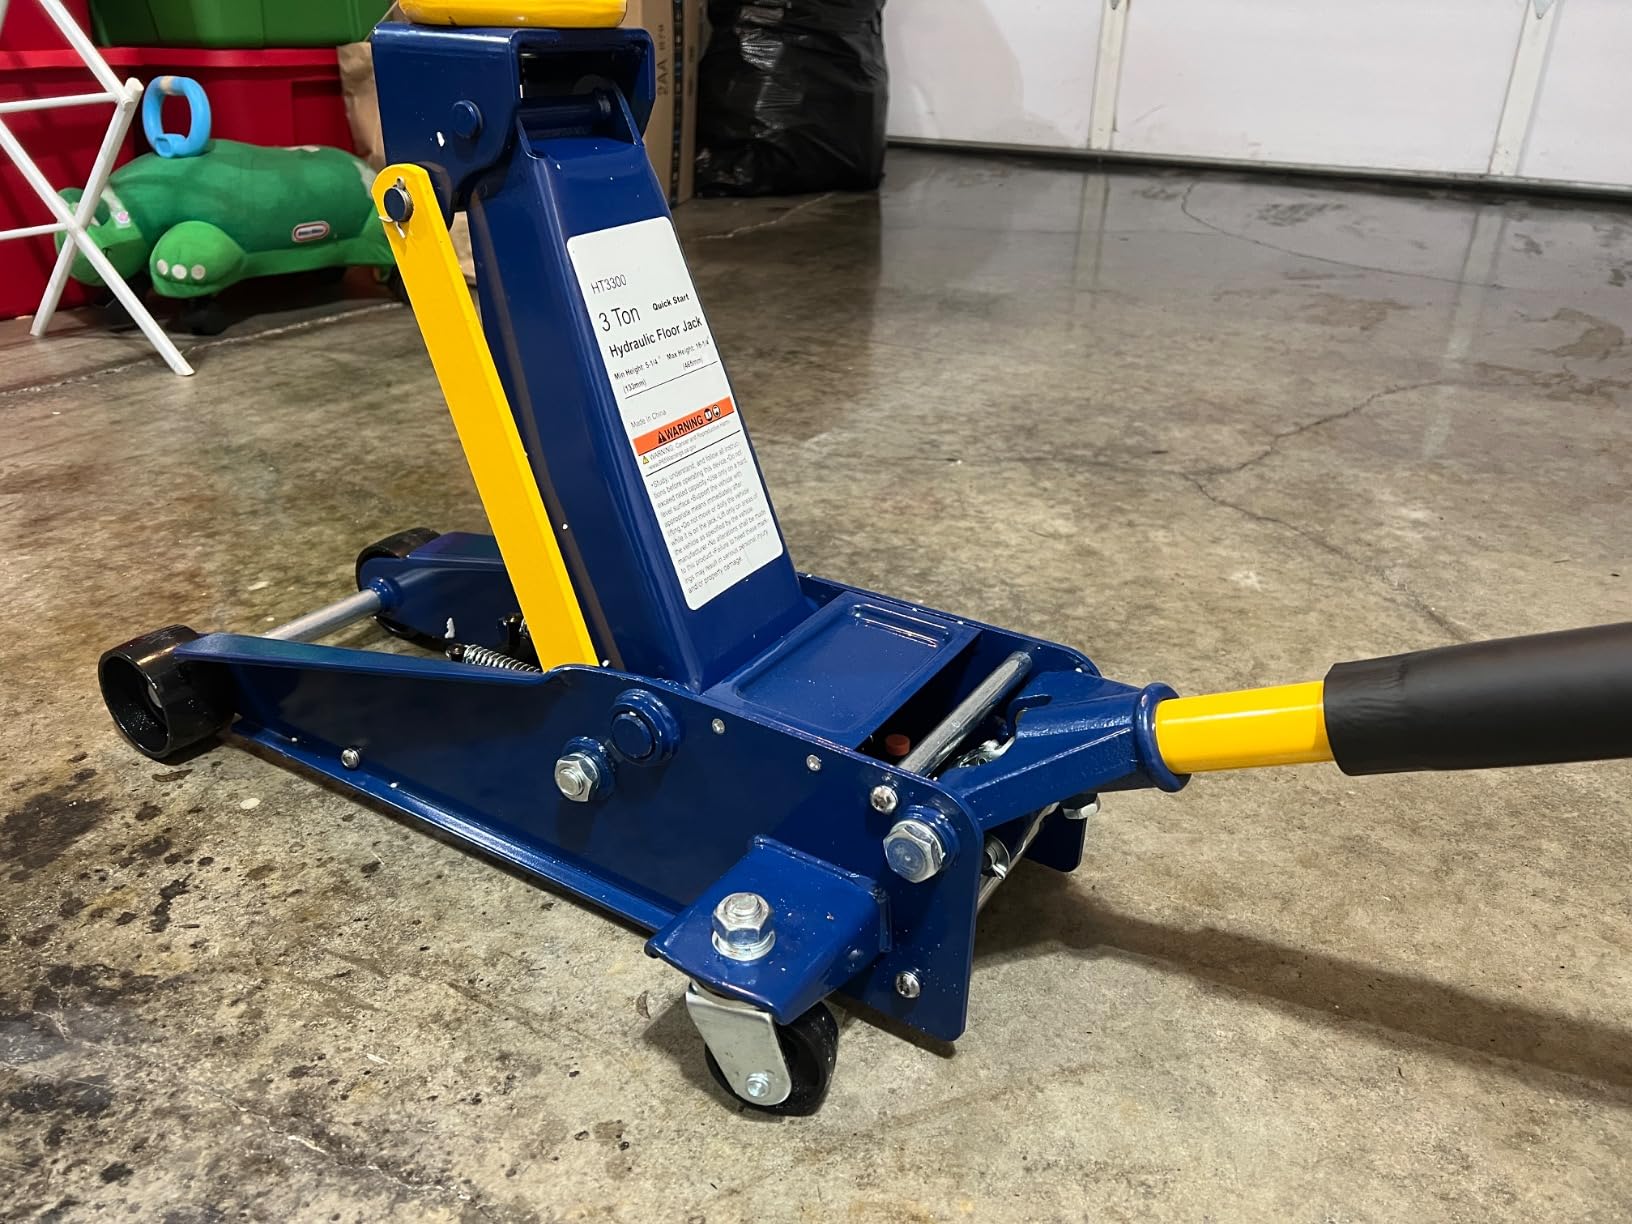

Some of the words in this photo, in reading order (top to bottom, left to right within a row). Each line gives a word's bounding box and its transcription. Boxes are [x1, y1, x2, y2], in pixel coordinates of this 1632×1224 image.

[590, 274, 627, 294] HT3300
[652, 299, 672, 311] Quick
[672, 293, 689, 304] Start
[599, 312, 611, 332] 3
[610, 307, 641, 327] Ton
[609, 333, 656, 358] Hydraulic
[656, 325, 680, 341] Floor
[683, 316, 702, 332] Jack
[677, 345, 695, 357] Height:
[624, 364, 643, 376] Height:
[630, 419, 646, 428] Made
[651, 409, 667, 420] China
[664, 414, 704, 440] WARNING
